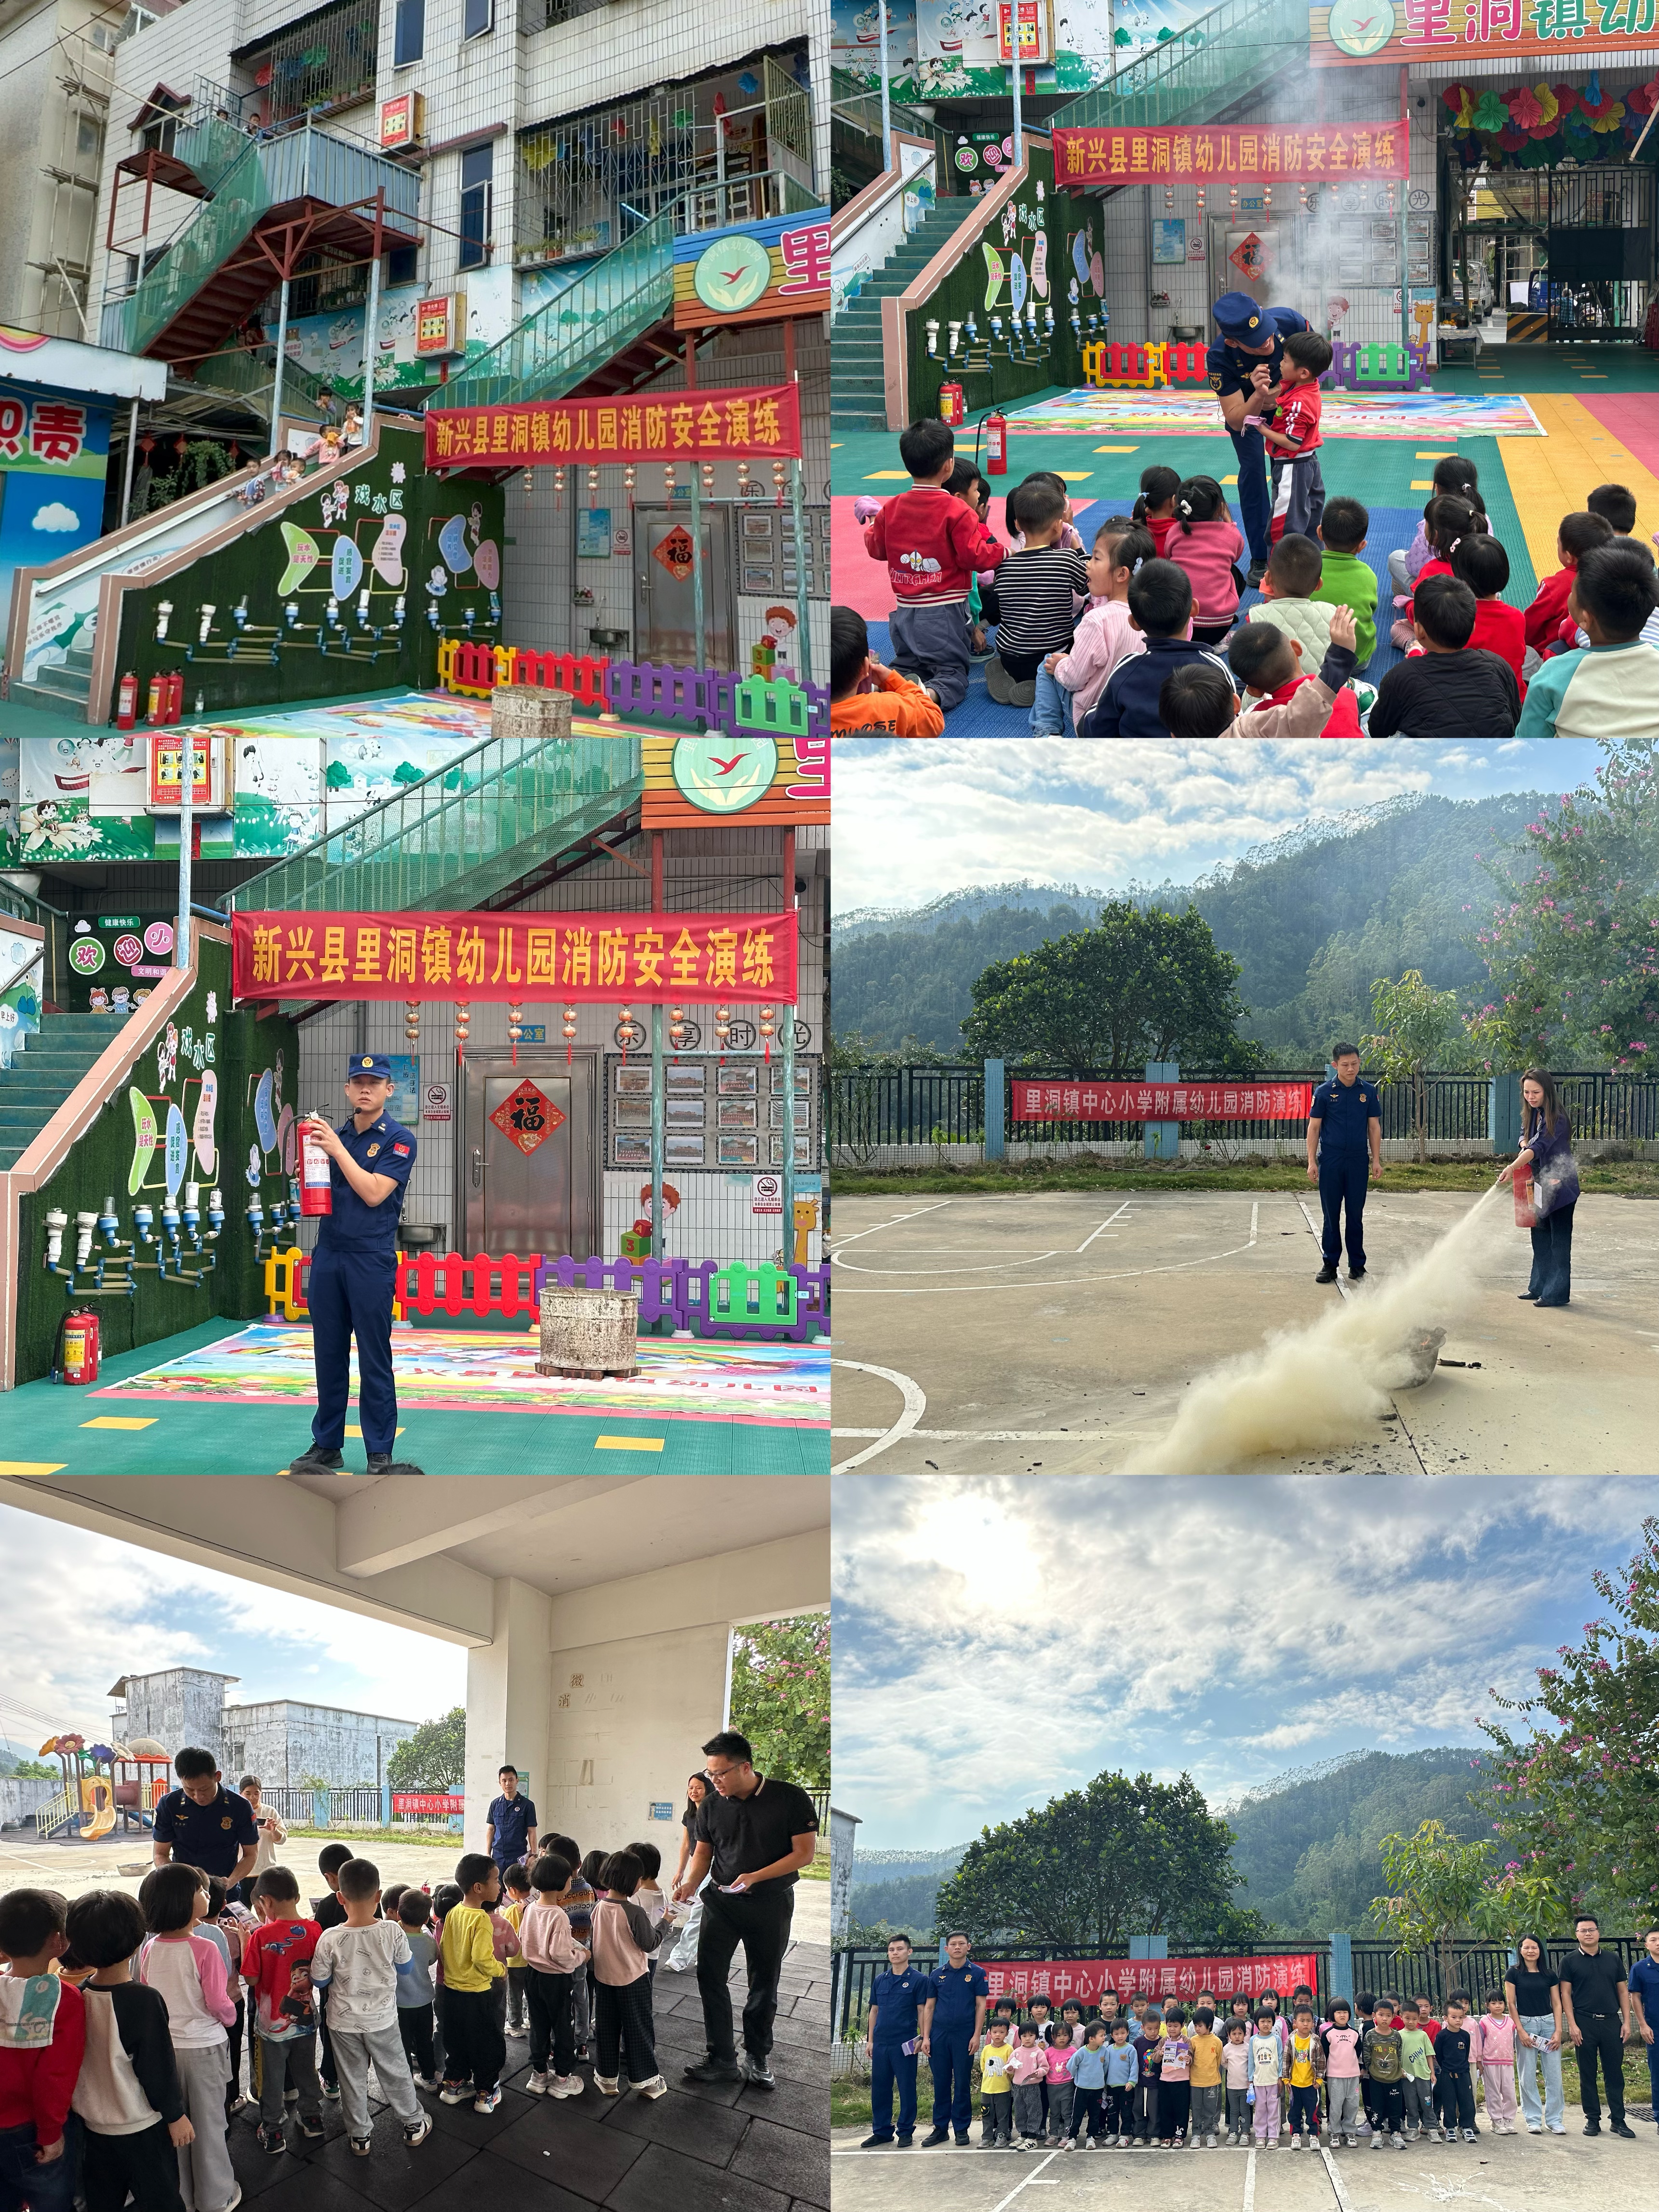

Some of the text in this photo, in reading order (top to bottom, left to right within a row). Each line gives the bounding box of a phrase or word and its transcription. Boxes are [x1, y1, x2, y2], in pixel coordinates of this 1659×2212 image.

[1067, 131, 1396, 174] 新兴县里洞镇幼儿园消防安全演练
[1242, 200, 1263, 208] 办公室
[1018, 203, 1045, 231] 戏水区
[1242, 243, 1264, 266] 福
[436, 398, 781, 456] 新兴县里洞镇幼儿园消防安全演练
[354, 483, 403, 514] 戏水区
[297, 543, 311, 552] 玩水
[667, 538, 692, 564] 福
[293, 555, 314, 564] 是天性
[890, 568, 942, 586] ULTRAMAN
[755, 650, 763, 661] 3
[252, 924, 775, 988] 新兴县里洞镇幼儿园消防安全演练
[138, 967, 167, 976] 文明和谐
[1, 1011, 15, 1023] 早上好
[520, 1027, 545, 1040] 公室
[181, 1026, 215, 1070] 戏水区
[403, 1064, 409, 1078] 七步
[1025, 1088, 1302, 1115] 里洞镇中心小学附属幼儿园消防演练
[510, 1096, 545, 1132] 福
[142, 1117, 151, 1131] 玩水
[138, 1134, 154, 1148] 是天性
[635, 1225, 642, 1233] A
[626, 1239, 635, 1252] 3
[571, 1675, 583, 1687] 微
[559, 1694, 570, 1707] 消
[986, 1963, 1306, 2001] 里洞镇中心小学附属幼儿园消防演练
[1408, 2047, 1424, 2063] CHINA
